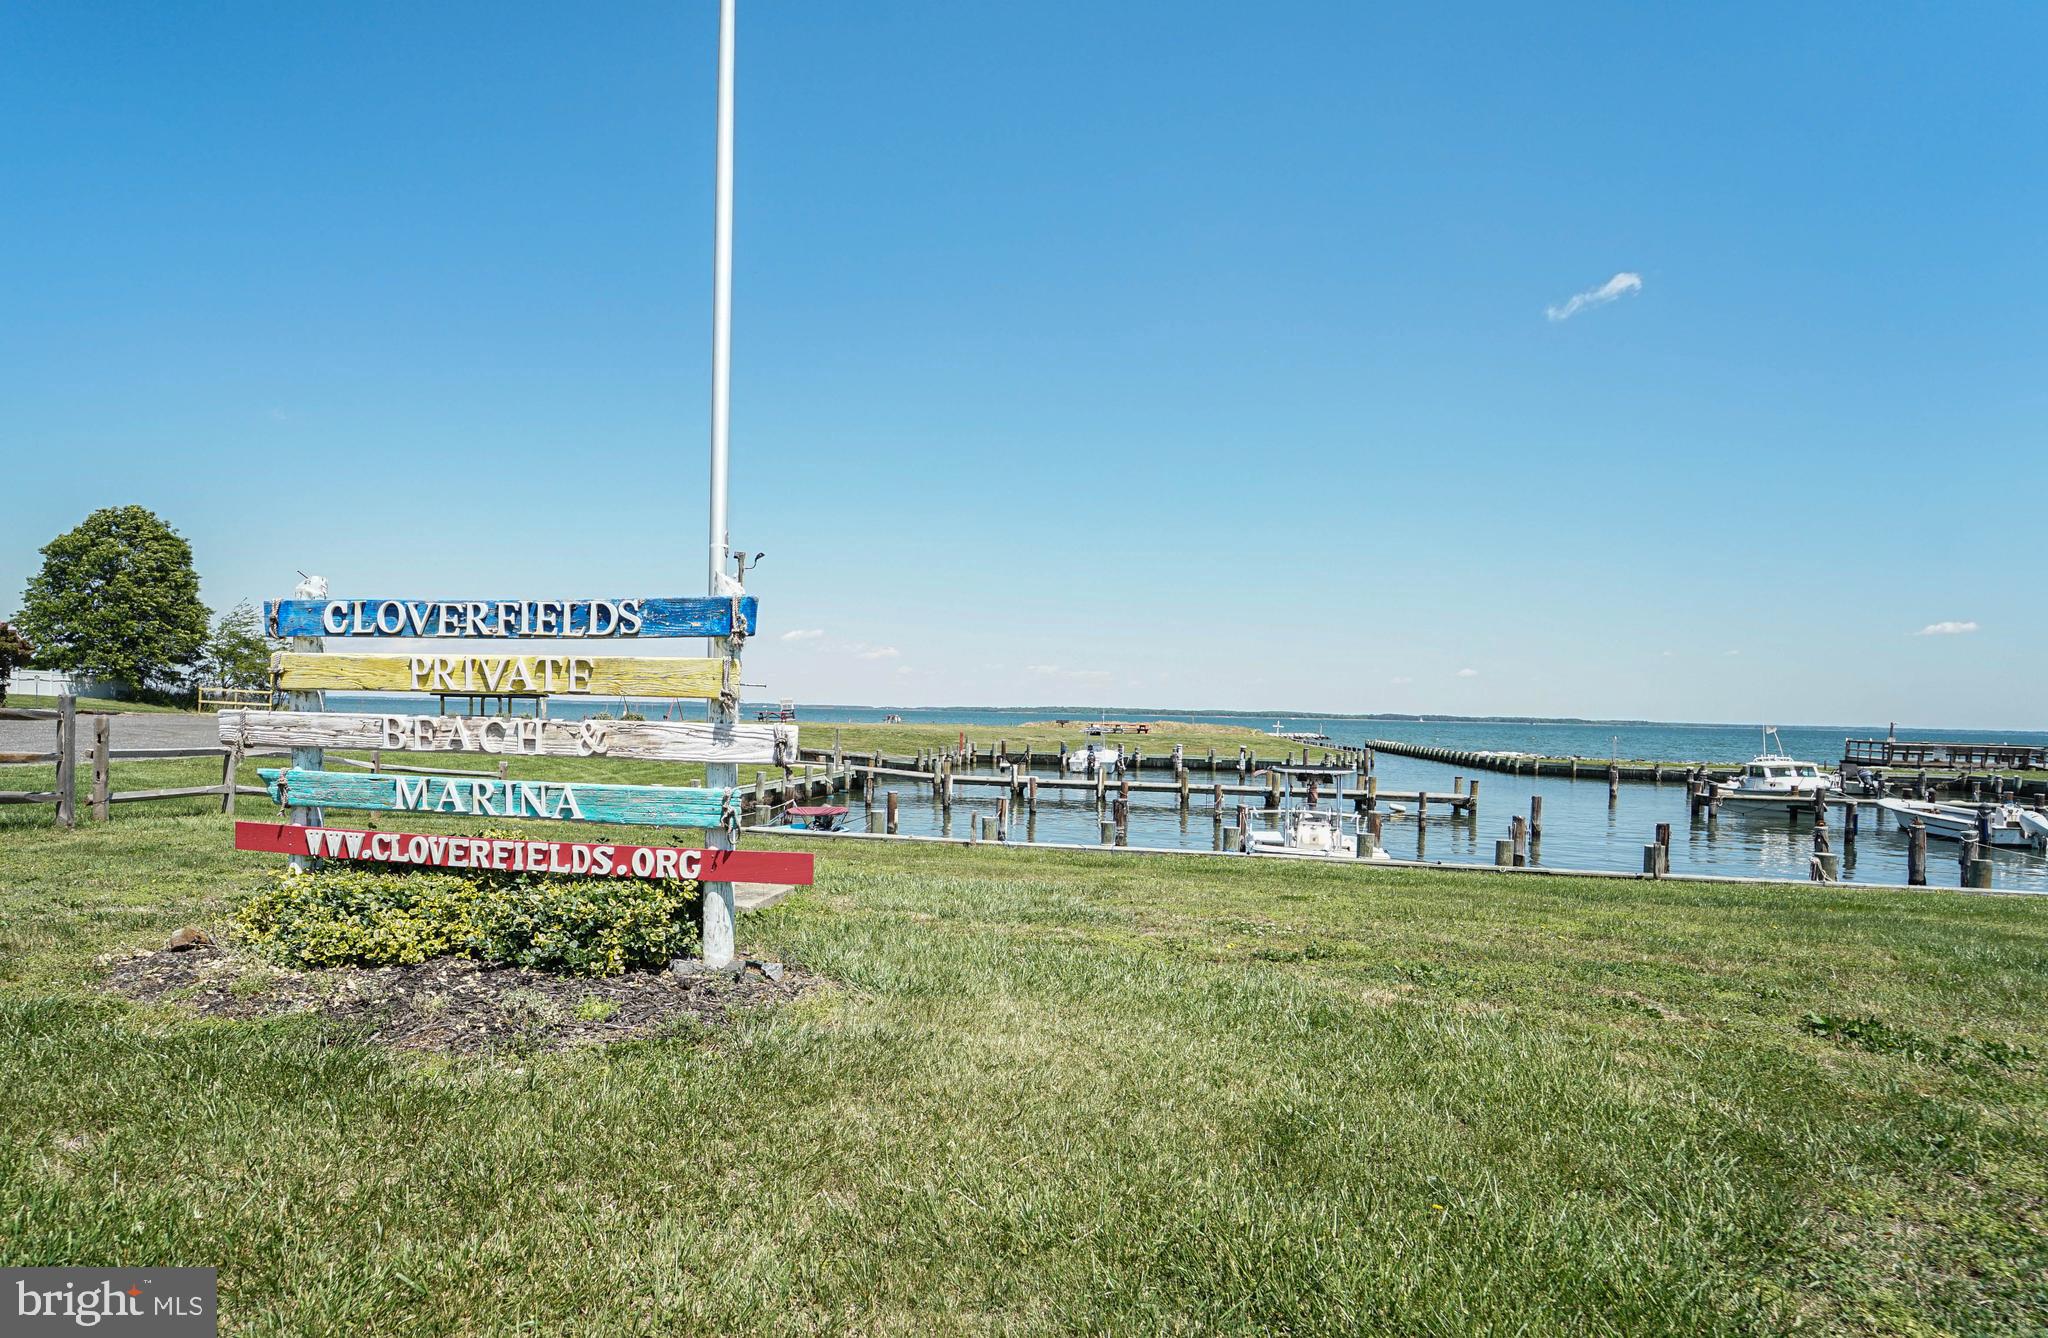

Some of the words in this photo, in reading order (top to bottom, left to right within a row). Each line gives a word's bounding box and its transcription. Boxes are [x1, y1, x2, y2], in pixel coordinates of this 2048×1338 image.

[323, 600, 642, 636] CLOVERFIELDS
[410, 656, 594, 693] PRIVATE
[381, 716, 545, 755] BEACH
[578, 721, 610, 757] &
[395, 777, 583, 819] MARINA
[305, 829, 701, 879] WWW.CLOVERFIELDS.ORG
